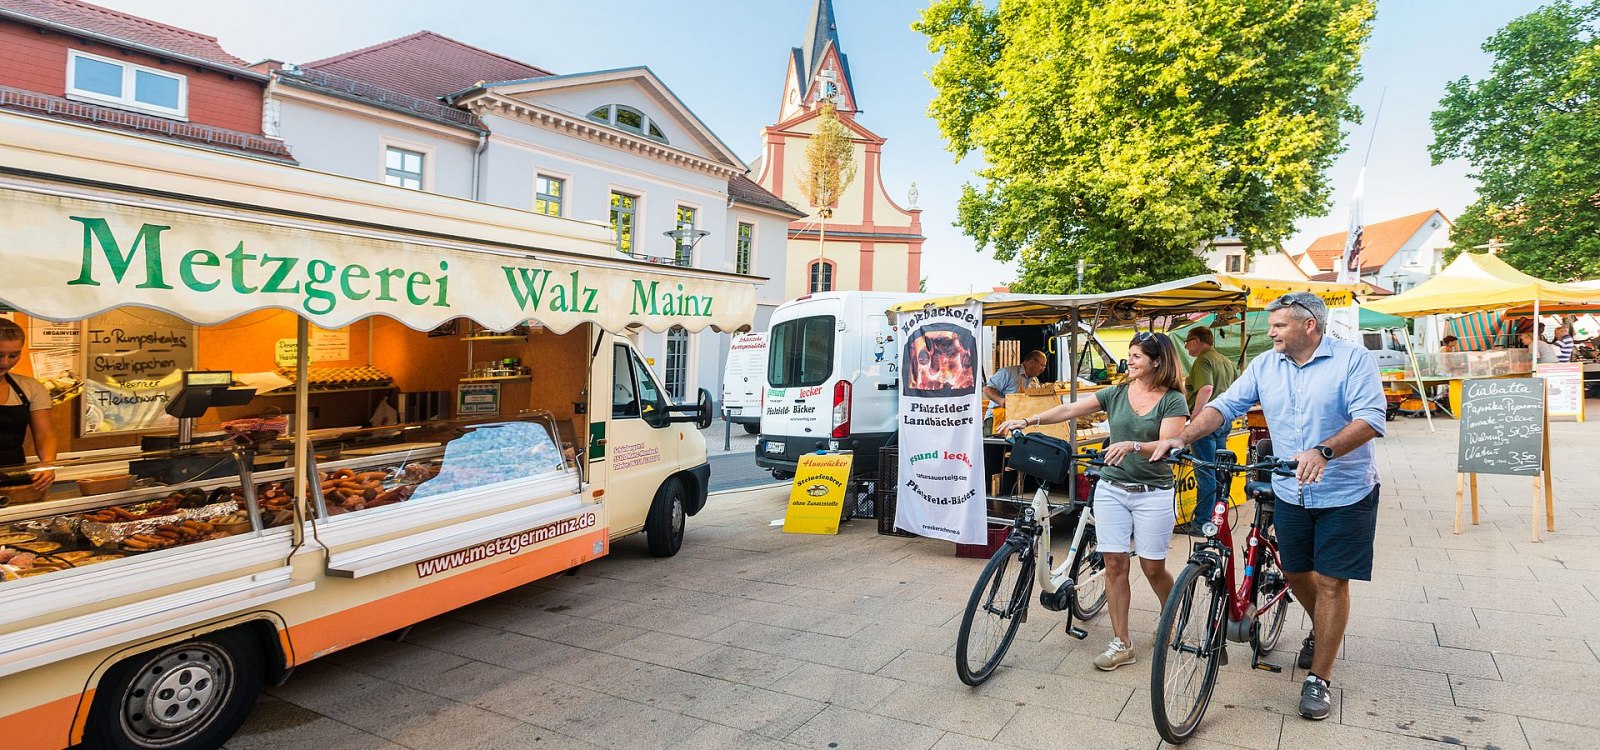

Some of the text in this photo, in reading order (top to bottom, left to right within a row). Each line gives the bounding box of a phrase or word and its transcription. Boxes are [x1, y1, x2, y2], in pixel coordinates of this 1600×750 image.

[67, 215, 713, 317] Metzgerei Walz Mainz
[799, 386, 823, 399] lecker
[1468, 382, 1533, 398] Ciabatta
[95, 390, 171, 406] Fleischwurst
[792, 404, 816, 414] Bäcker
[910, 402, 971, 414] Pfalzfelder
[903, 415, 974, 427] Landbäckere
[802, 459, 848, 467] Hunsrücker
[943, 451, 973, 468] leck
[416, 511, 596, 579] www.metzgermainz.de
